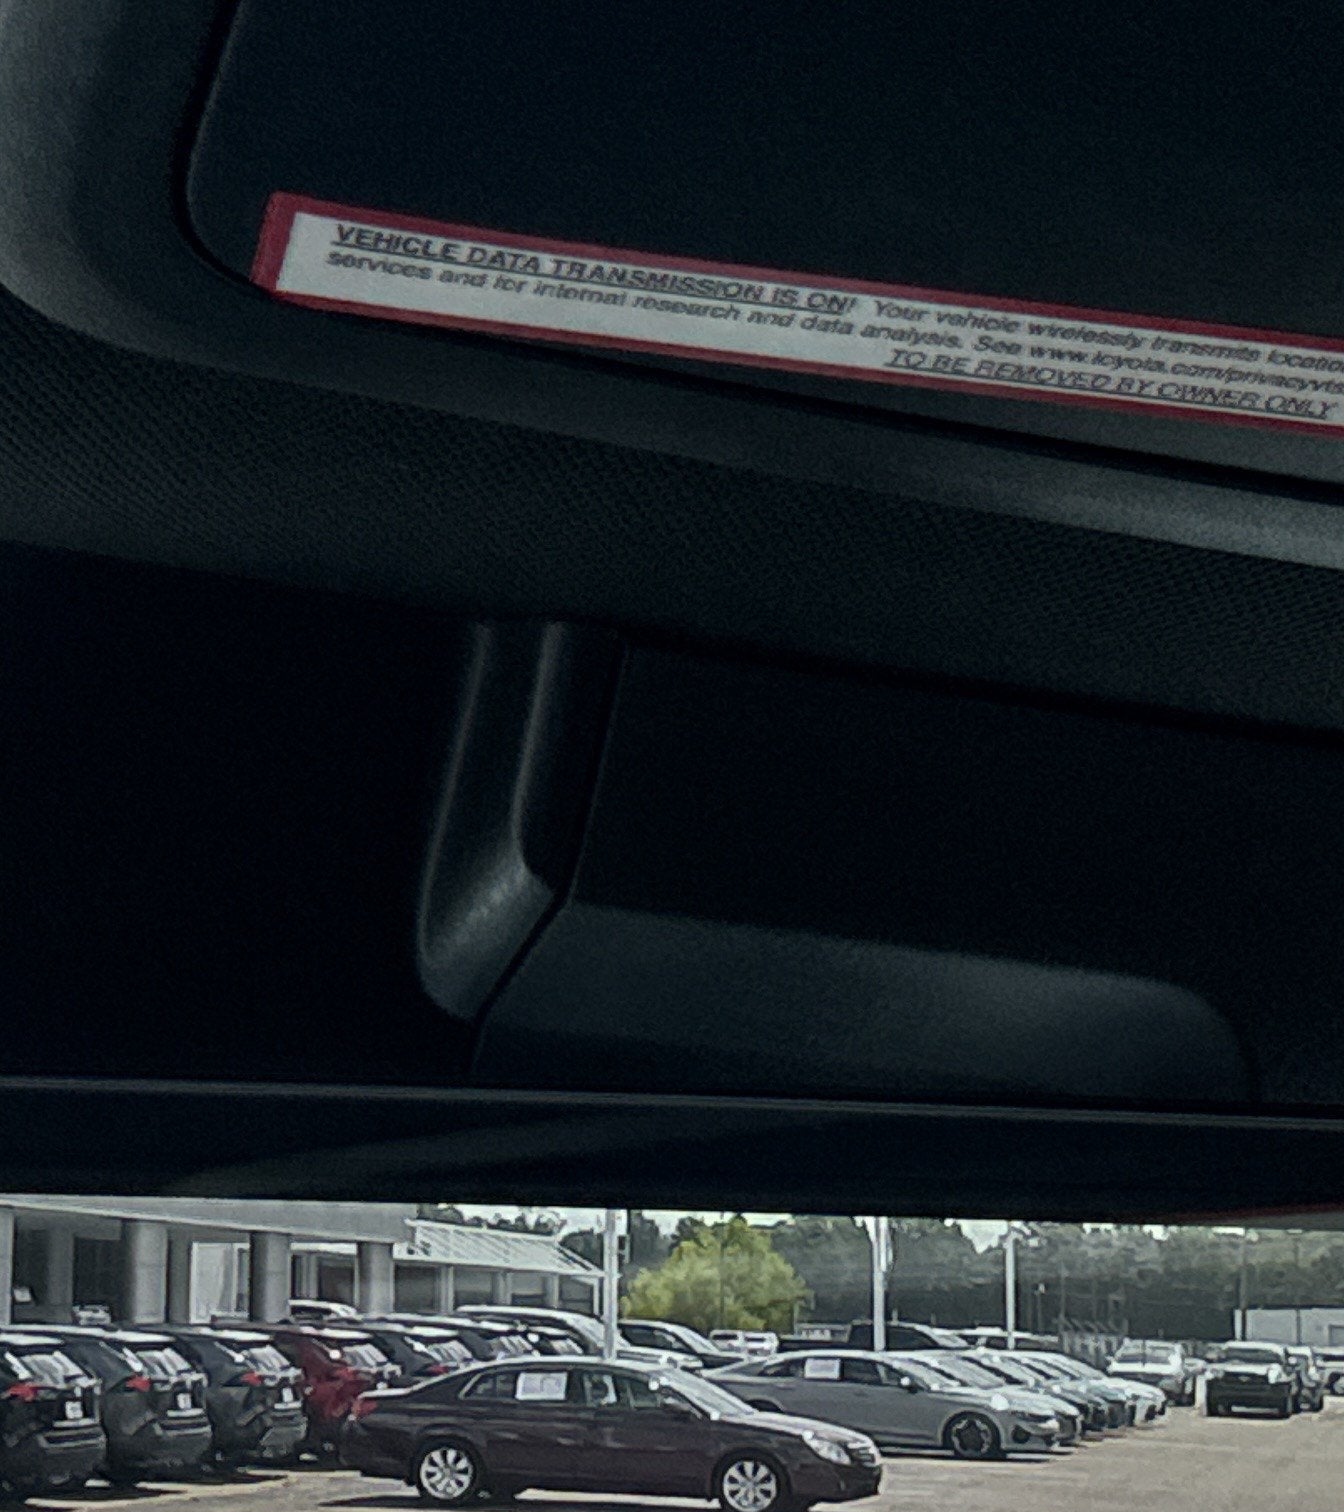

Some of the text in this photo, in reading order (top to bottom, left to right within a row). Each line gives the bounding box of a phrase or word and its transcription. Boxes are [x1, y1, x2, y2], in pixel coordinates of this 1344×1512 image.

[326, 251, 434, 281] services
[436, 269, 489, 290] and
[493, 275, 529, 293] for
[532, 279, 626, 307] internal
[632, 291, 741, 322] research
[746, 309, 796, 328] and
[800, 314, 854, 336] data
[971, 335, 1024, 355] See
[331, 224, 460, 263] VEHICLE
[465, 247, 540, 275] DATA
[550, 257, 764, 305] TRANSMISSION
[772, 287, 800, 306] IS
[874, 300, 931, 323] Your
[937, 310, 1023, 333] vehicle
[1027, 321, 1145, 351] wirelessly
[1149, 336, 1263, 362] transmits
[888, 348, 1339, 420] TO BE REMOVED BY OWNER ONLY
